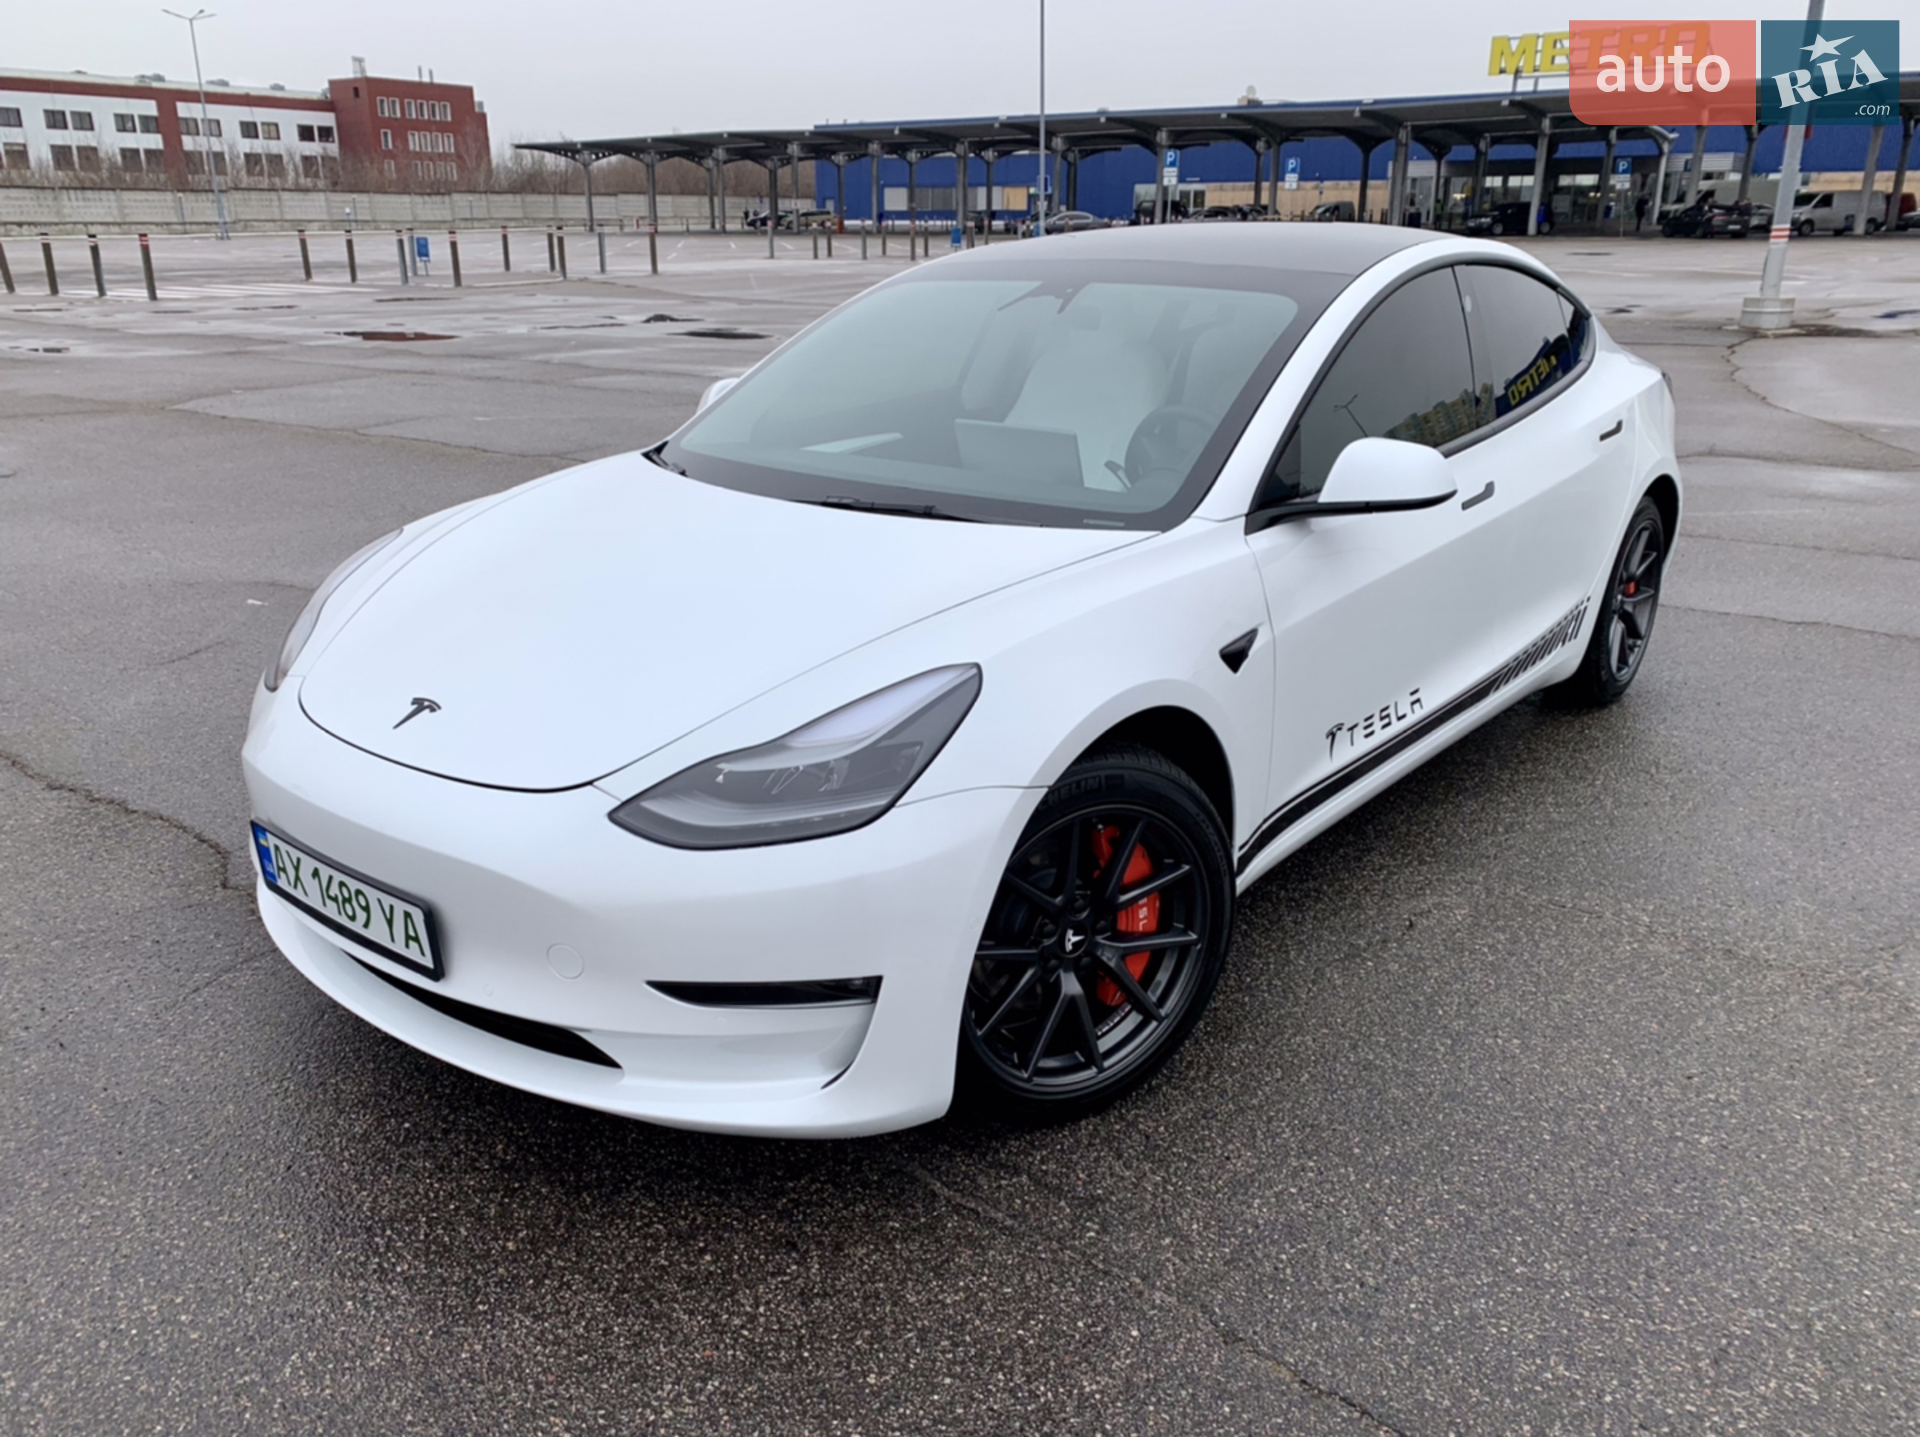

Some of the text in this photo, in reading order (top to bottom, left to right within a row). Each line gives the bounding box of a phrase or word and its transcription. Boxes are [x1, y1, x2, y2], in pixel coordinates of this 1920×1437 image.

[1346, 687, 1424, 747] TESLA
[273, 843, 427, 958] AX 1489 YA
